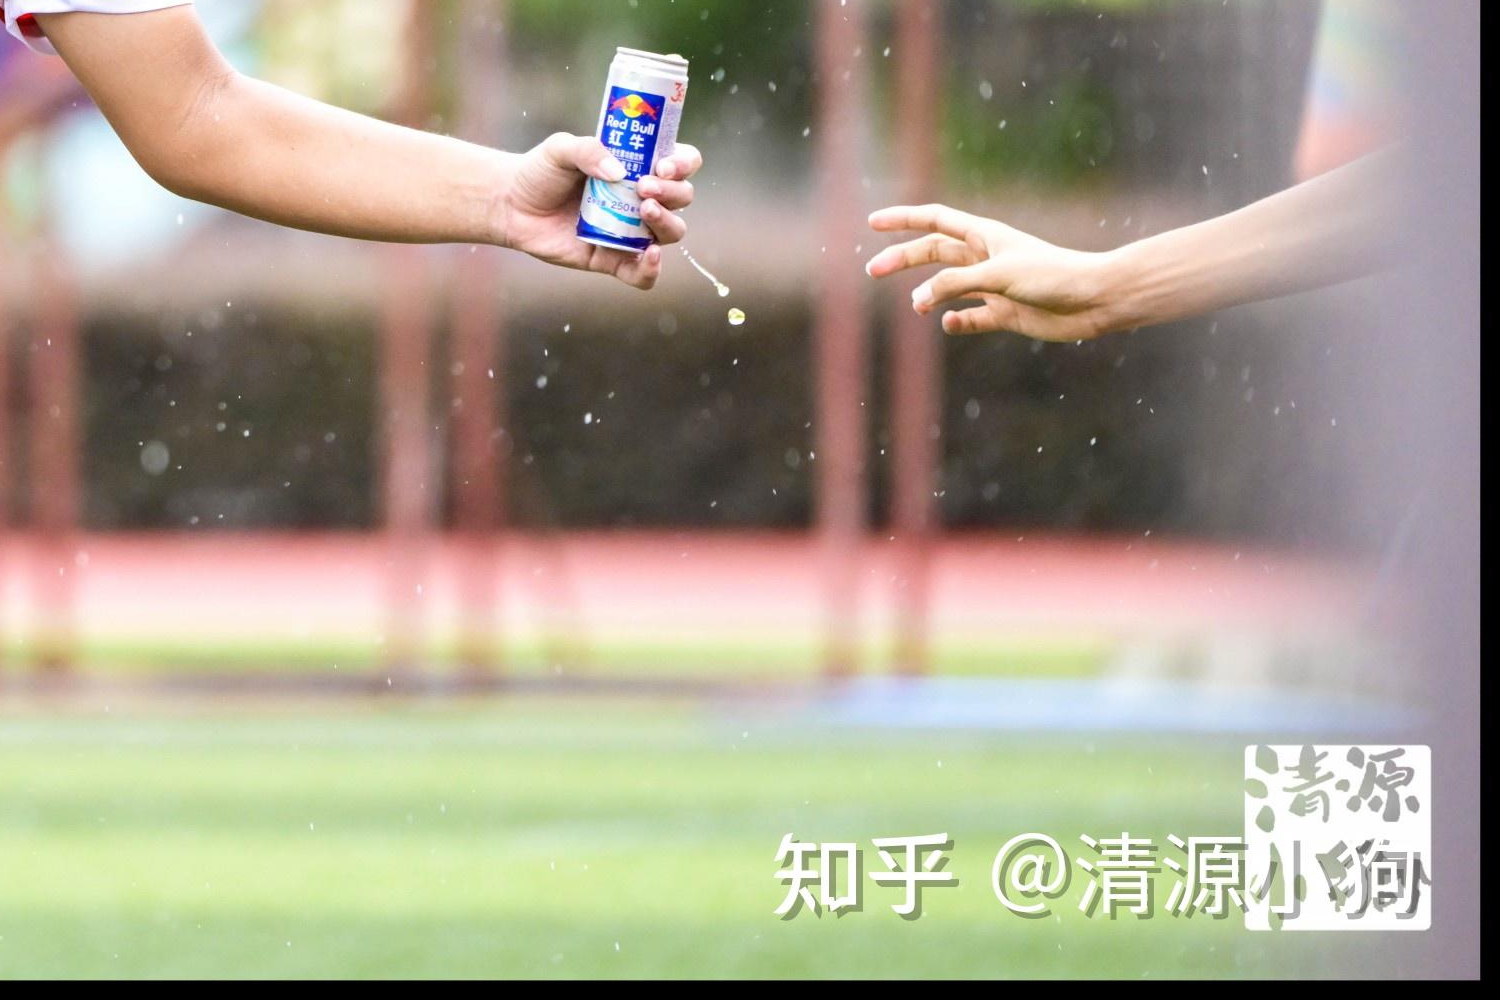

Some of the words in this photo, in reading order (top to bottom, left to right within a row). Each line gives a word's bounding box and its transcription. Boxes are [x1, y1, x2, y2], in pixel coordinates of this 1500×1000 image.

[607, 114, 628, 130] Red
[630, 120, 655, 135] Bull
[608, 130, 645, 150] 红牛
